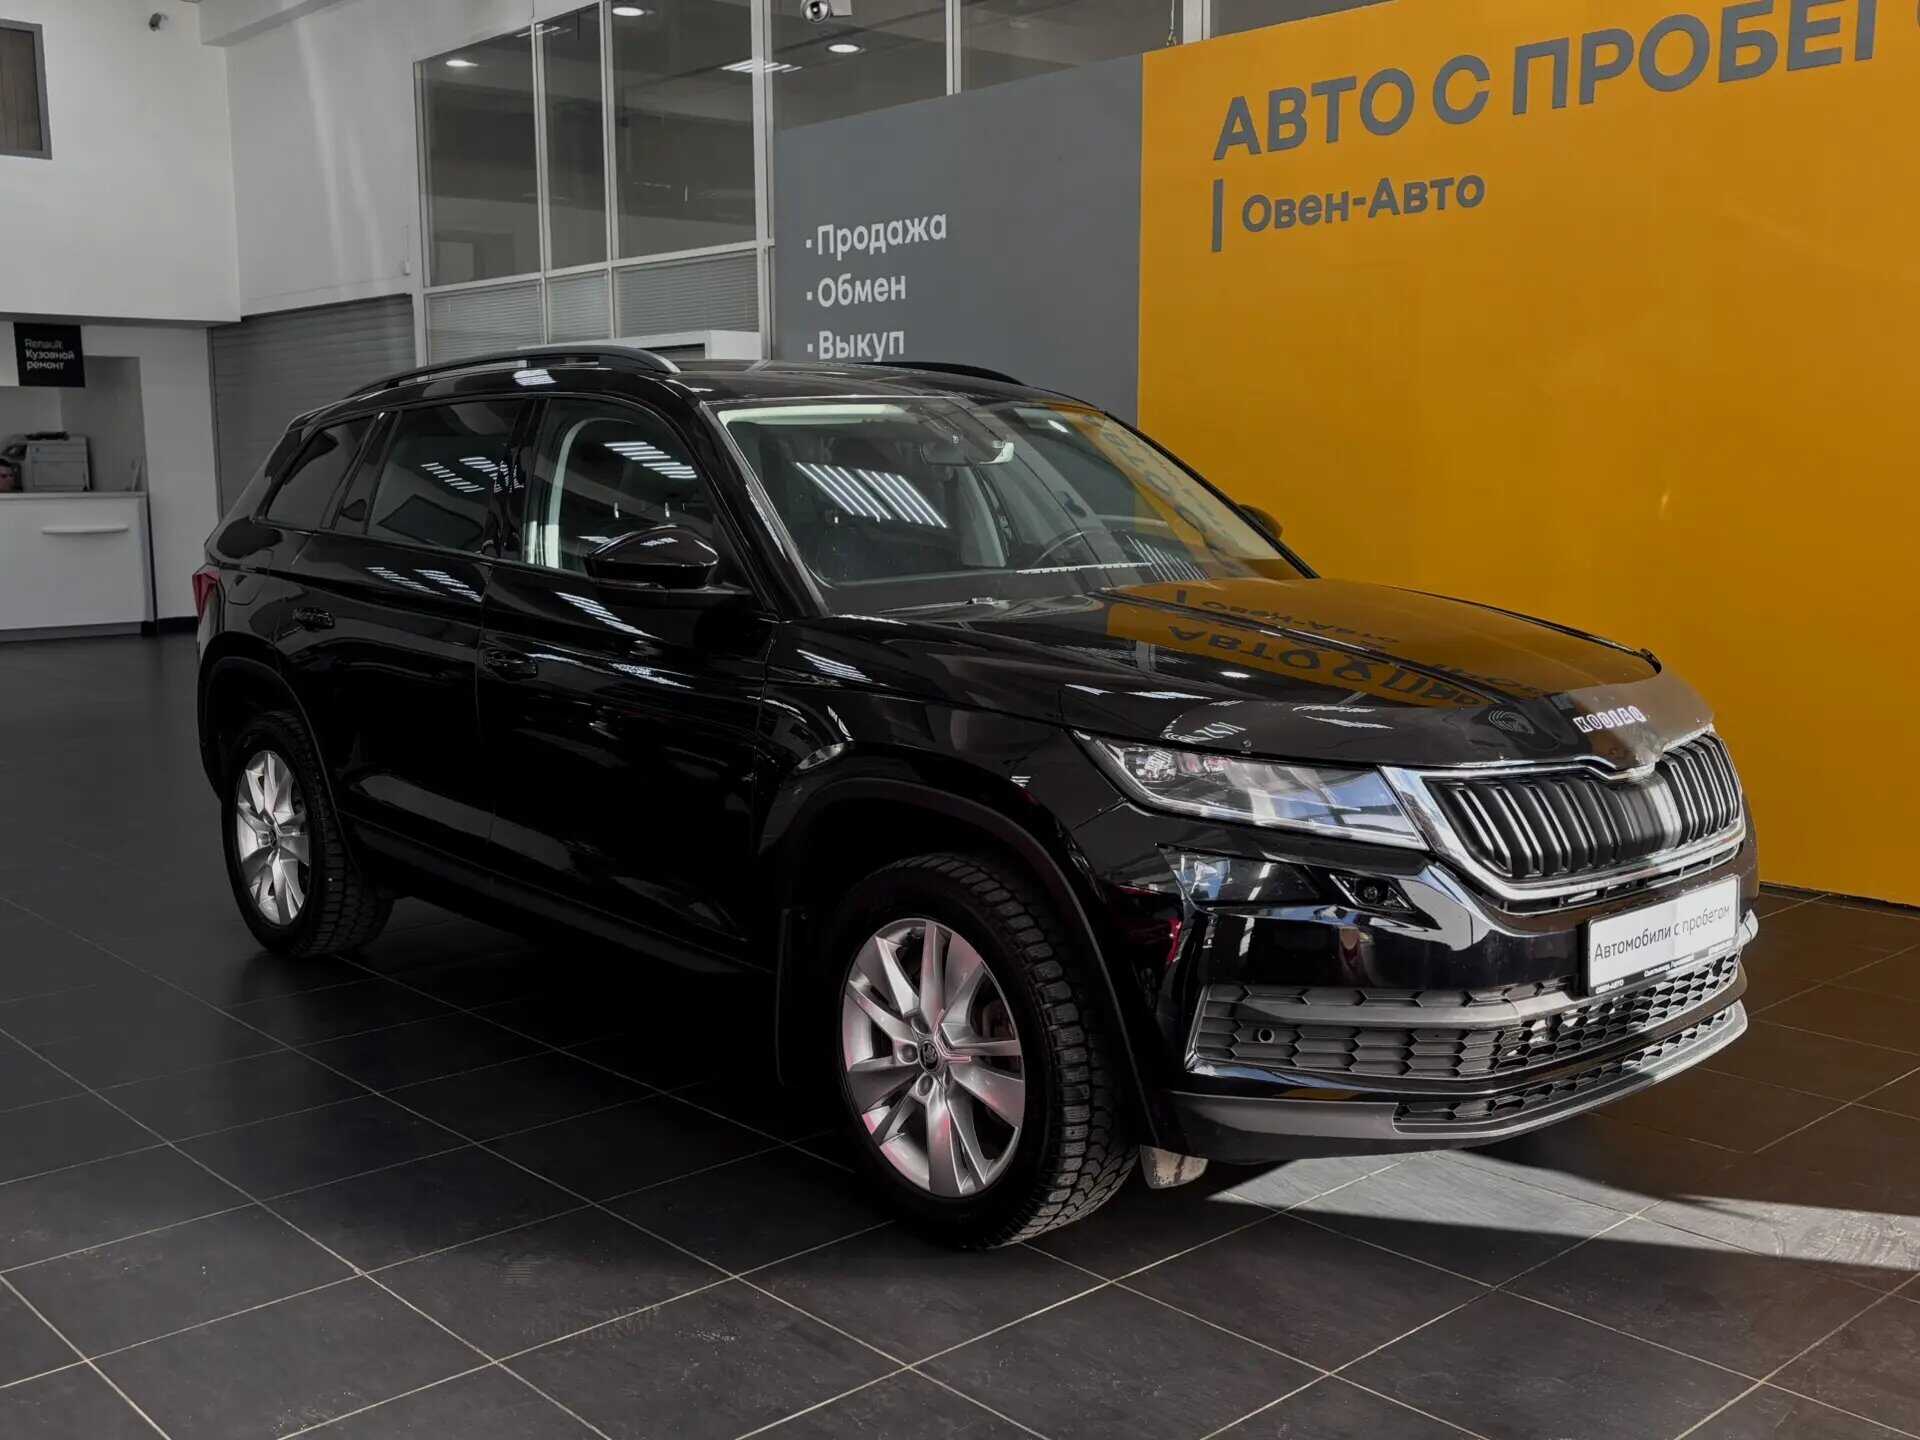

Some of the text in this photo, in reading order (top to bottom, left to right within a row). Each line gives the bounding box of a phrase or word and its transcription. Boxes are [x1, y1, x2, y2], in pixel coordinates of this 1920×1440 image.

[1213, 67, 1415, 160] АВТО
[1432, 54, 1490, 125] С
[1242, 174, 1485, 232] Овен-Авто
[817, 213, 947, 261] Продажа
[817, 273, 906, 307] Обмен
[818, 330, 905, 362] Выкуп
[1594, 905, 1730, 961] Автомобили с пробегом
